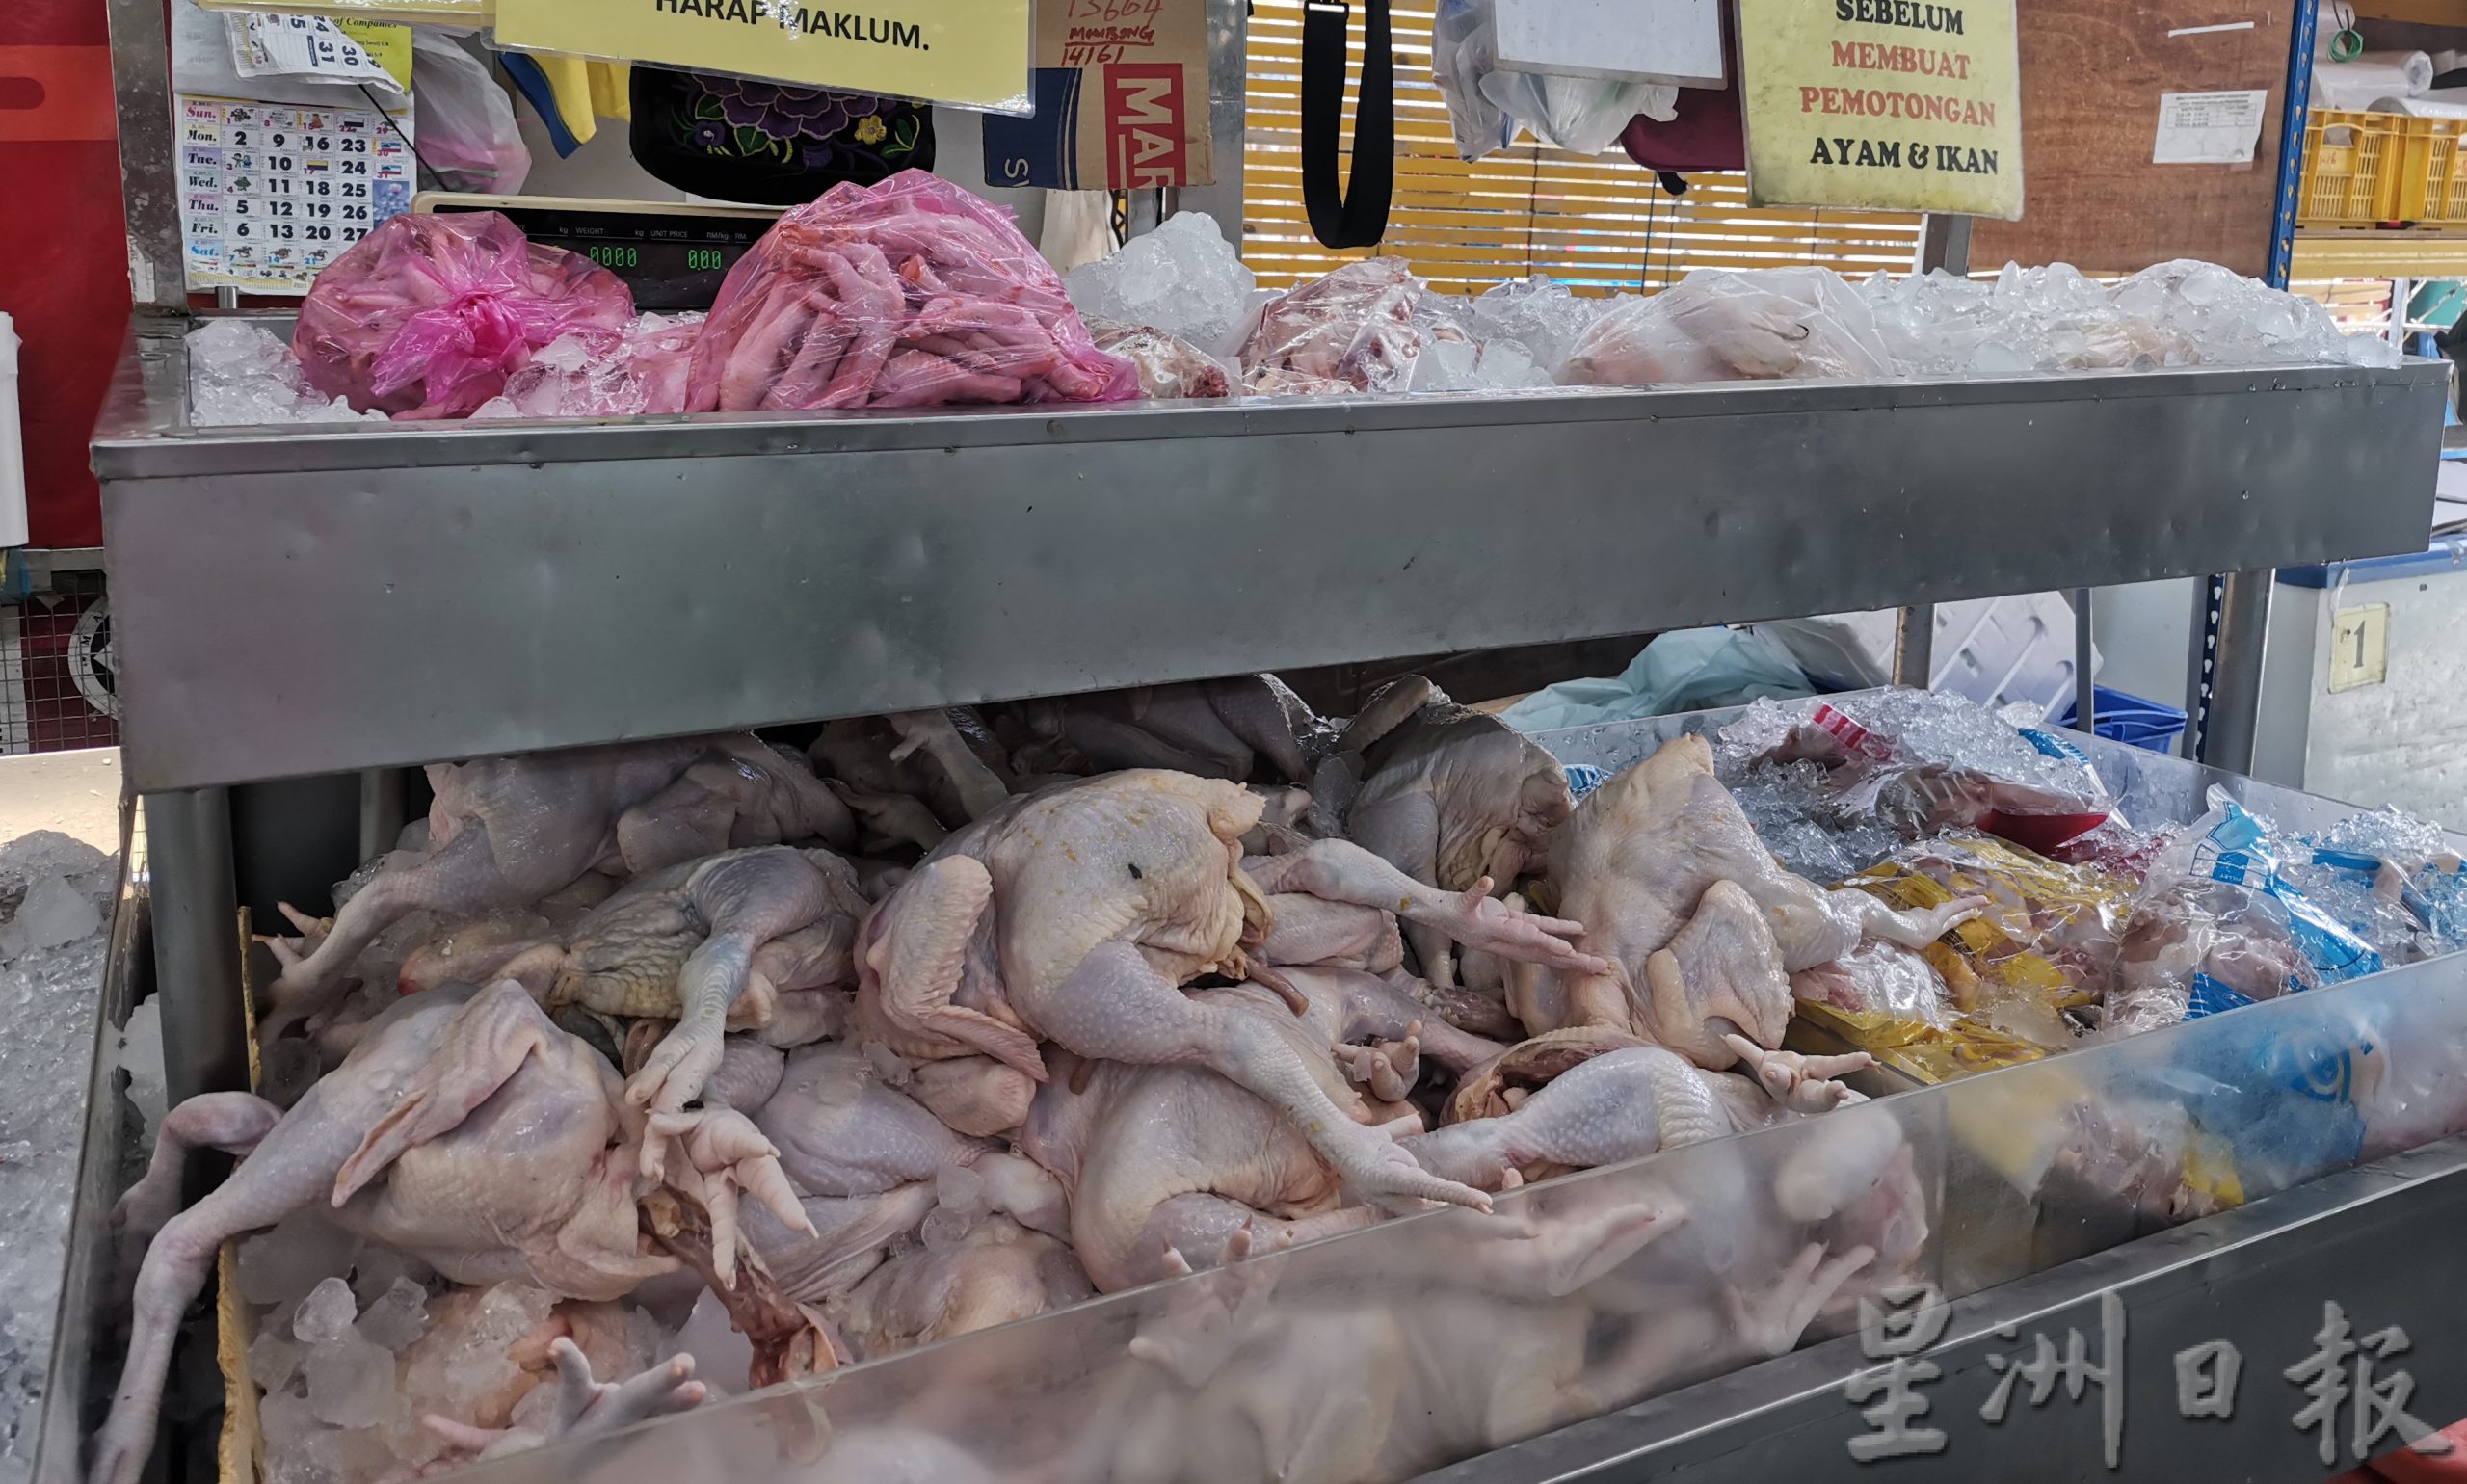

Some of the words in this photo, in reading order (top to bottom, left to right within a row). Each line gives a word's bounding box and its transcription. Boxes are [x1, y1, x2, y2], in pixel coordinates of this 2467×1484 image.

[1835, 0, 1964, 35] SEBELUM
[1831, 40, 1971, 80] MEMBUAT
[187, 106, 217, 119] Sun.
[1799, 86, 1996, 127] PEMOTONGAN
[187, 129, 217, 142] Mon.
[234, 131, 247, 146] 2
[273, 133, 285, 147] 9
[305, 136, 330, 150] 16
[341, 138, 366, 152] 23
[188, 153, 217, 165] Tue.
[269, 156, 292, 171] 10
[342, 160, 366, 174] 24
[1810, 137, 1900, 168] AYAM
[1908, 143, 1929, 169] &
[1936, 145, 1998, 175] IKAN
[189, 176, 218, 188] Wed.
[269, 179, 290, 193] 11
[306, 180, 330, 195] 18
[342, 182, 366, 197] 25
[189, 199, 219, 211] Thu.
[236, 200, 249, 214] 5
[270, 201, 293, 216] 12
[307, 203, 331, 218] 19
[343, 205, 368, 220] 26
[192, 223, 218, 234] Fri.
[237, 223, 250, 236] 6
[270, 225, 294, 239] 13
[306, 225, 331, 240] 20
[343, 227, 368, 241] 27
[576, 227, 604, 236] WEIGHT
[706, 232, 729, 241] RM/kg
[2353, 620, 2366, 669] 1
